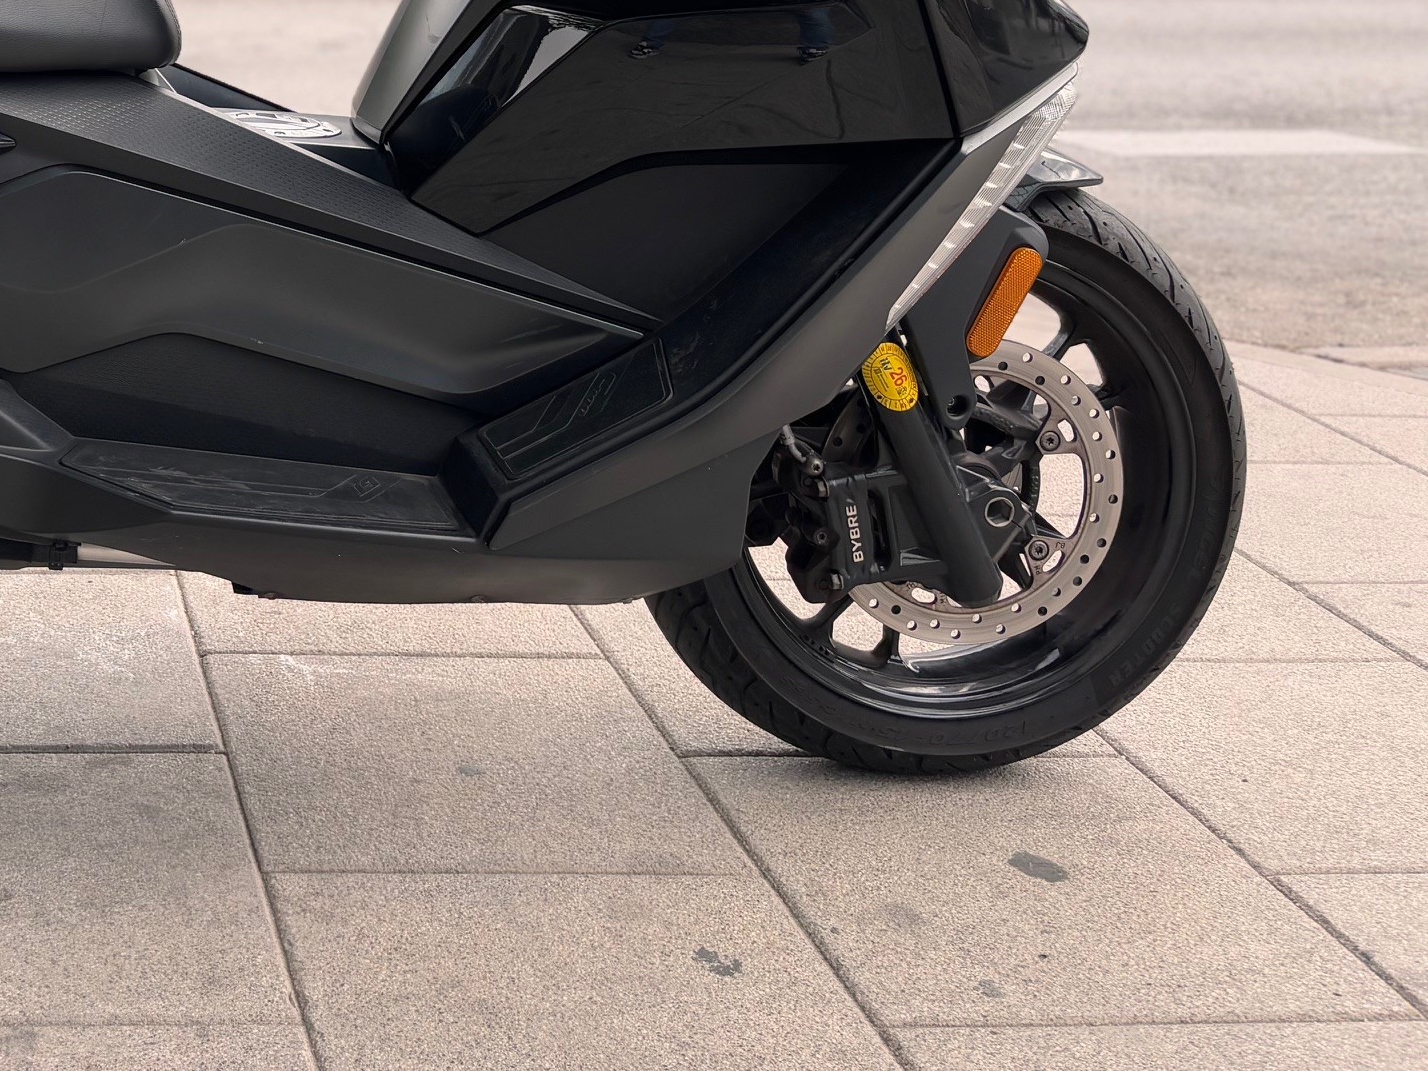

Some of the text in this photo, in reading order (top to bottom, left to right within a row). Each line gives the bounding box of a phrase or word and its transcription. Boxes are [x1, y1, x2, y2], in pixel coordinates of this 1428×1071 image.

[889, 366, 908, 387] 26
[844, 504, 865, 564] BYBRE
[1104, 598, 1185, 692] SCOOTER
